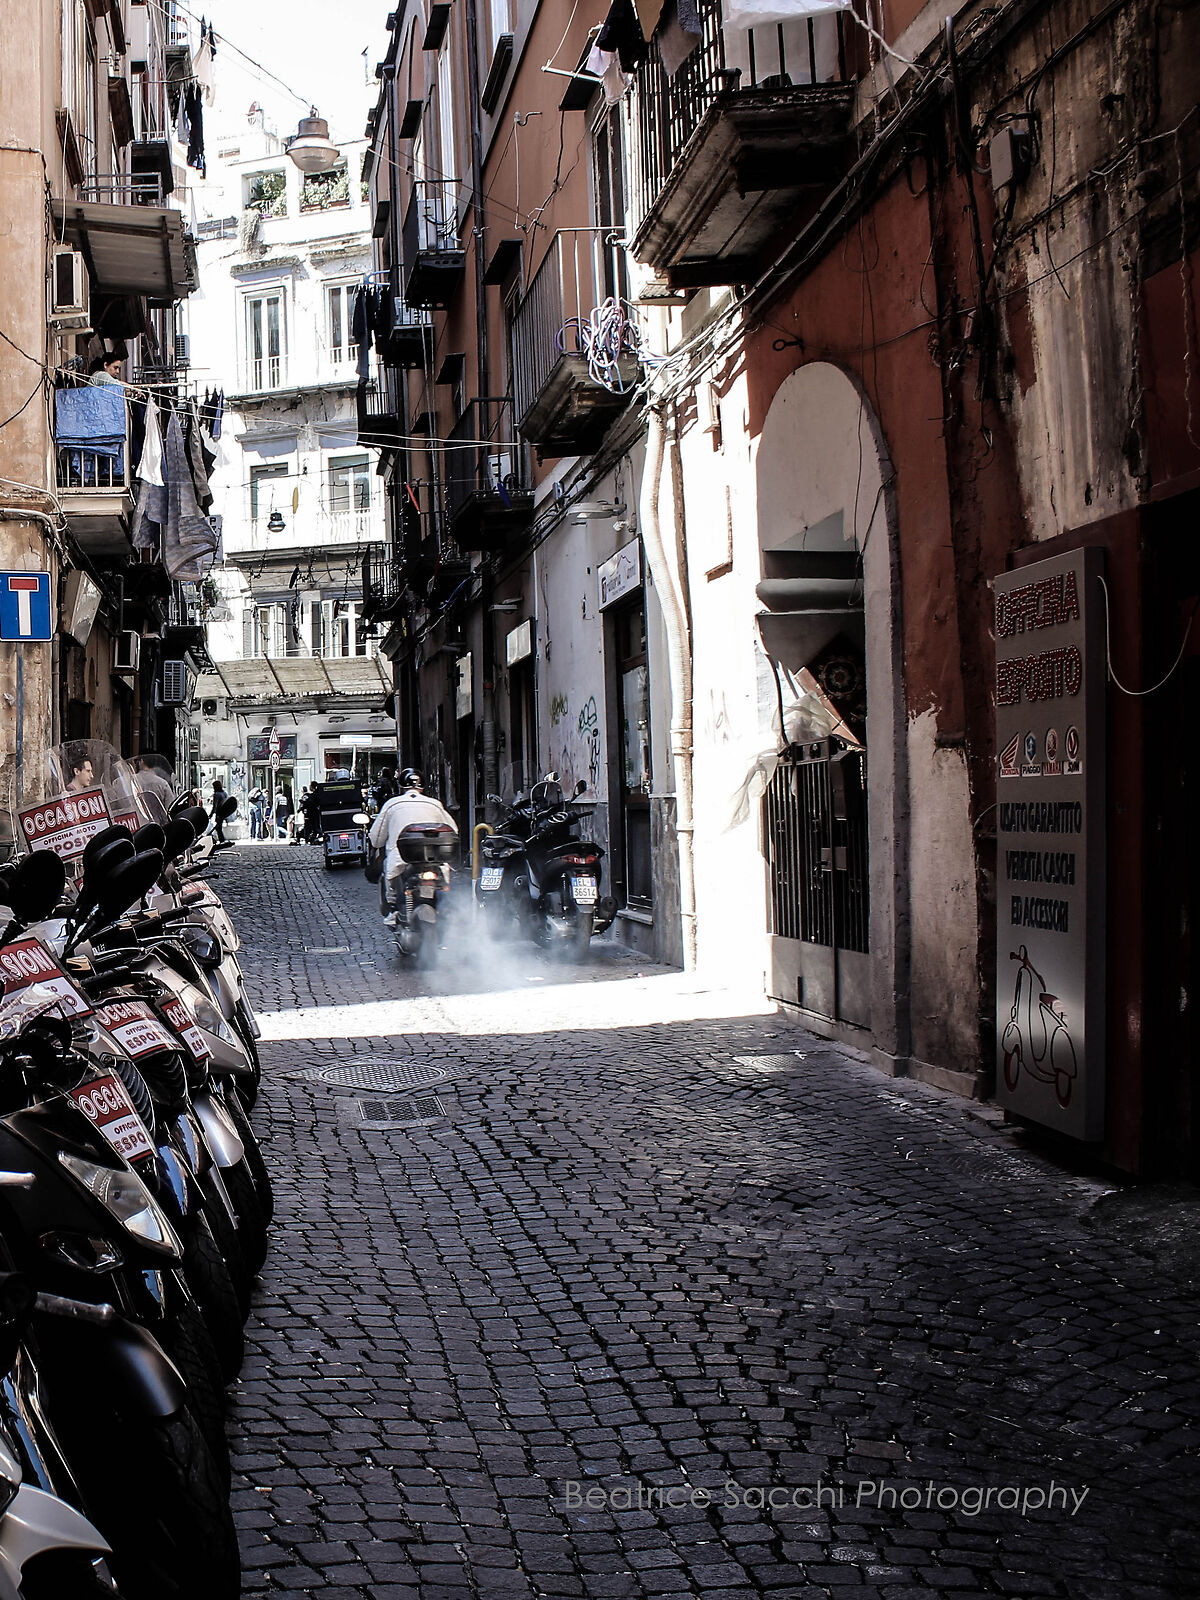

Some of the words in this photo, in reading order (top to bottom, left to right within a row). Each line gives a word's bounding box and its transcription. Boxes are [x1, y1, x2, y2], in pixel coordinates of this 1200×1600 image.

[996, 570, 1080, 639] OFFICINA
[23, 795, 107, 836] OCCASIONI
[1000, 802, 1028, 833] USATO
[1028, 801, 1082, 834] GARANTITO
[43, 831, 74, 846] OFFICINA
[76, 825, 97, 835] MOTO
[113, 1130, 148, 1154] ESPO
